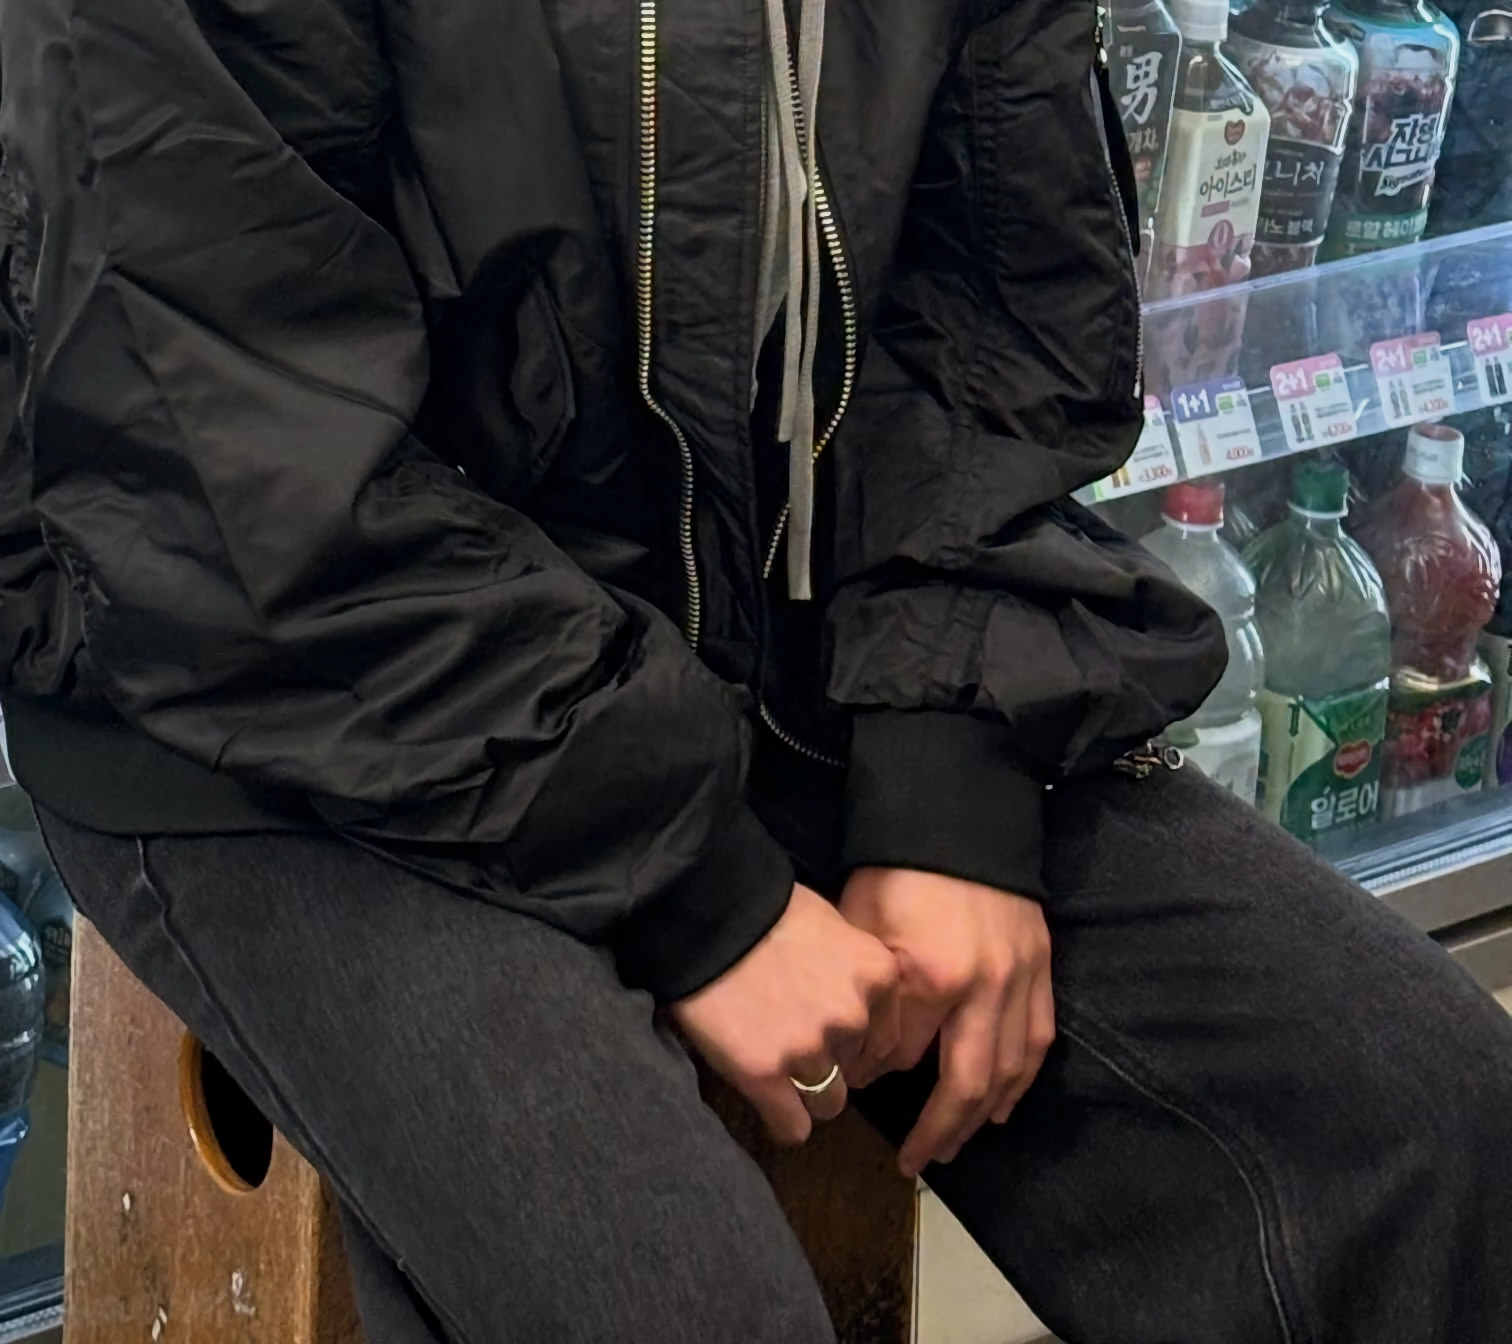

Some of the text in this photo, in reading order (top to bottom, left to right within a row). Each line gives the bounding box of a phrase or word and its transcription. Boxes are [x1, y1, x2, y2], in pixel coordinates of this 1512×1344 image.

[1120, 51, 1163, 125] 男
[1199, 163, 1257, 202] 아이스티
[1374, 344, 1407, 370] 2+1
[1275, 367, 1308, 395] 2+1
[1177, 389, 1211, 416] 1+1
[1310, 784, 1380, 832] 알로에
